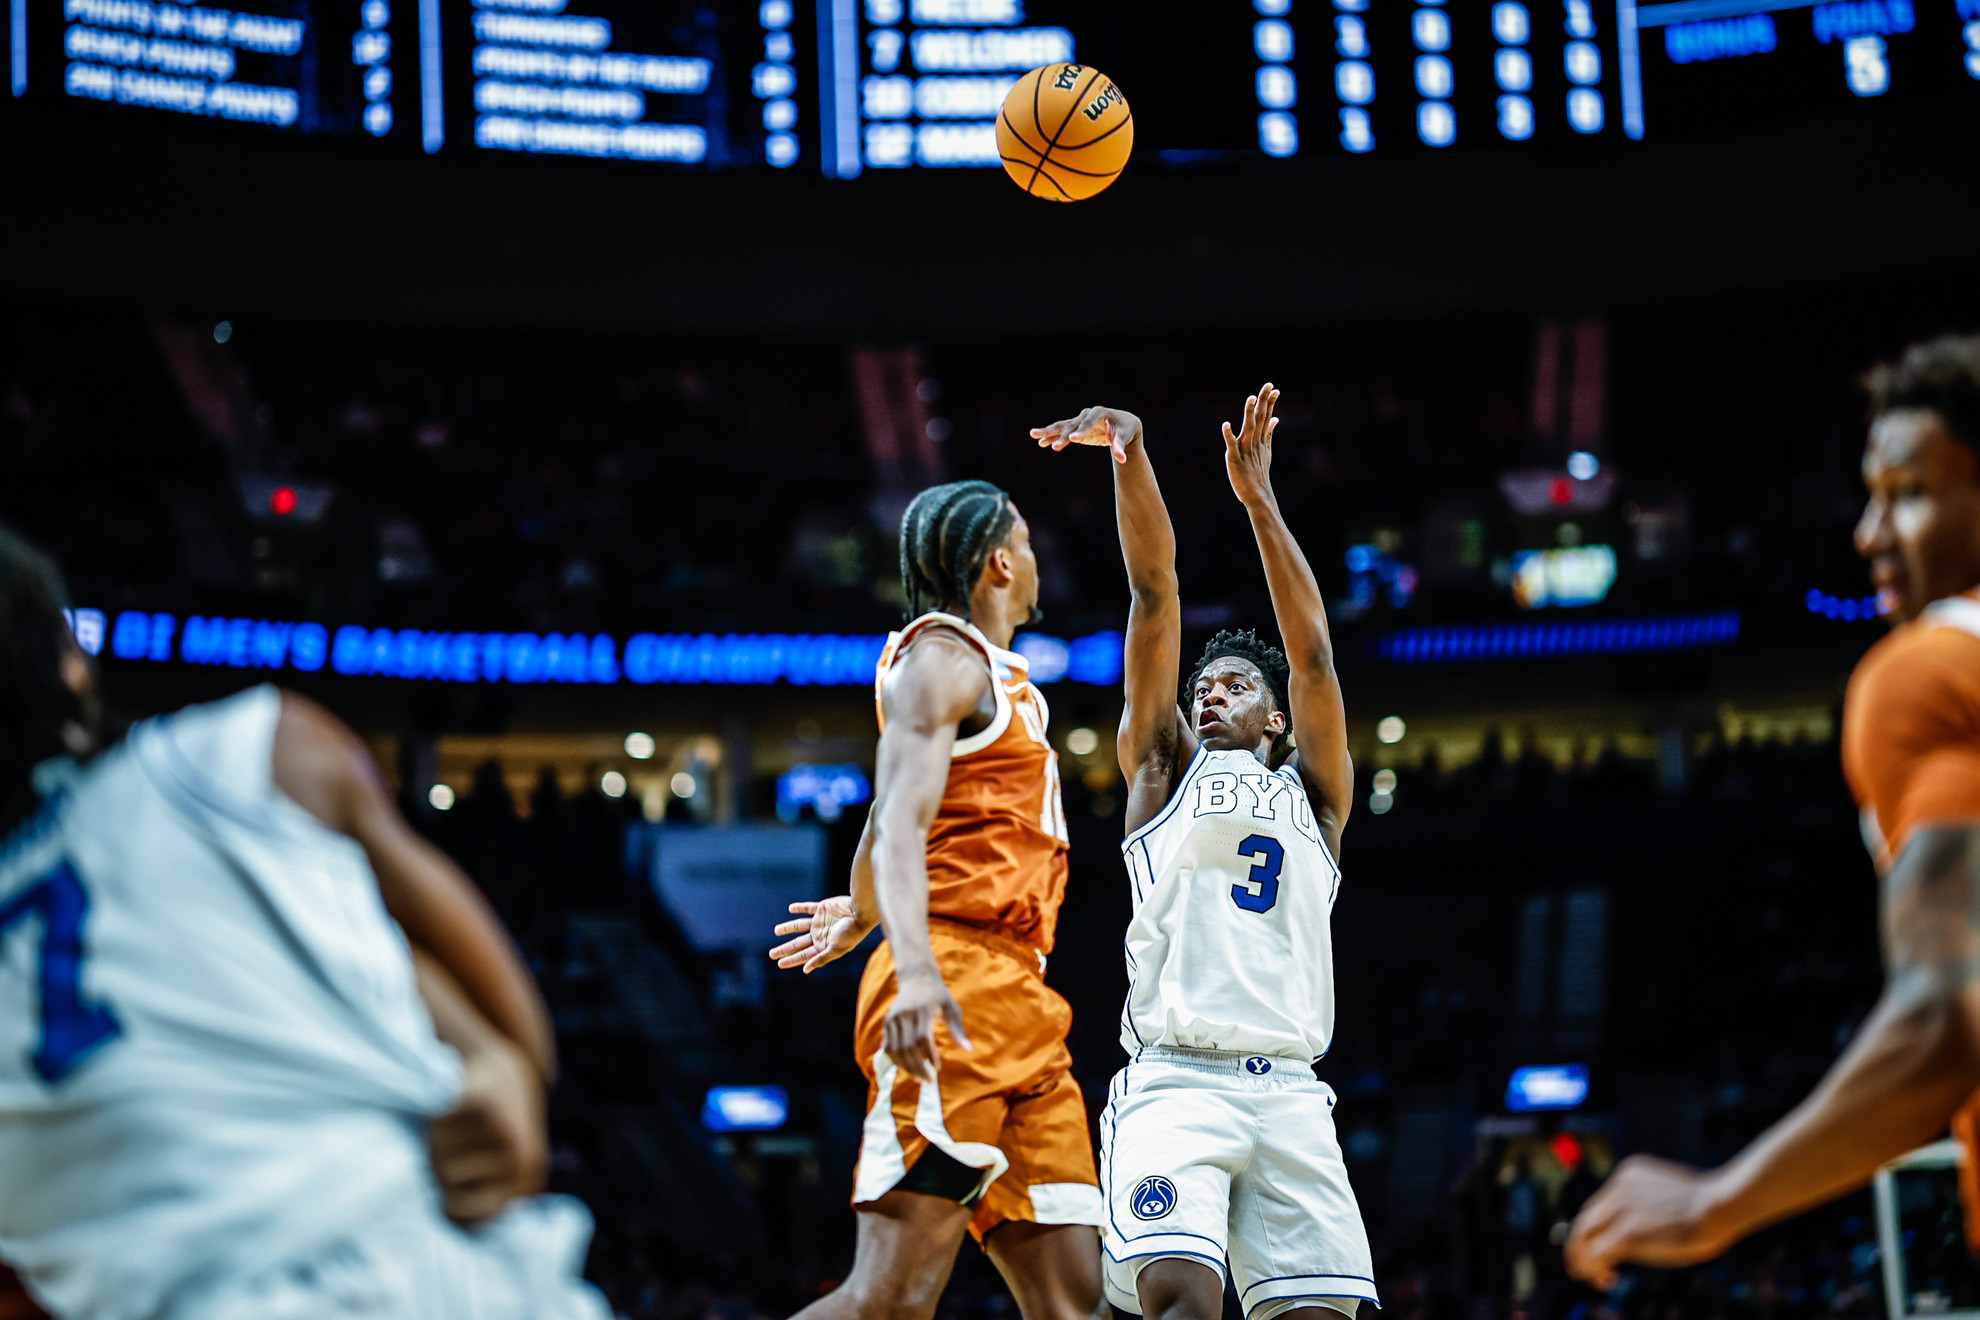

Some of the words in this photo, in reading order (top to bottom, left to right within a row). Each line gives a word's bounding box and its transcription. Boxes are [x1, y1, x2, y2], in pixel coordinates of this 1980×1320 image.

[1054, 64, 1084, 91] CAA
[180, 614, 329, 672] MEN'S
[332, 624, 621, 683] BASKETBALL
[624, 632, 886, 686] CHAMPION
[1231, 833, 1285, 914] 3
[1250, 1058, 1269, 1074] Y
